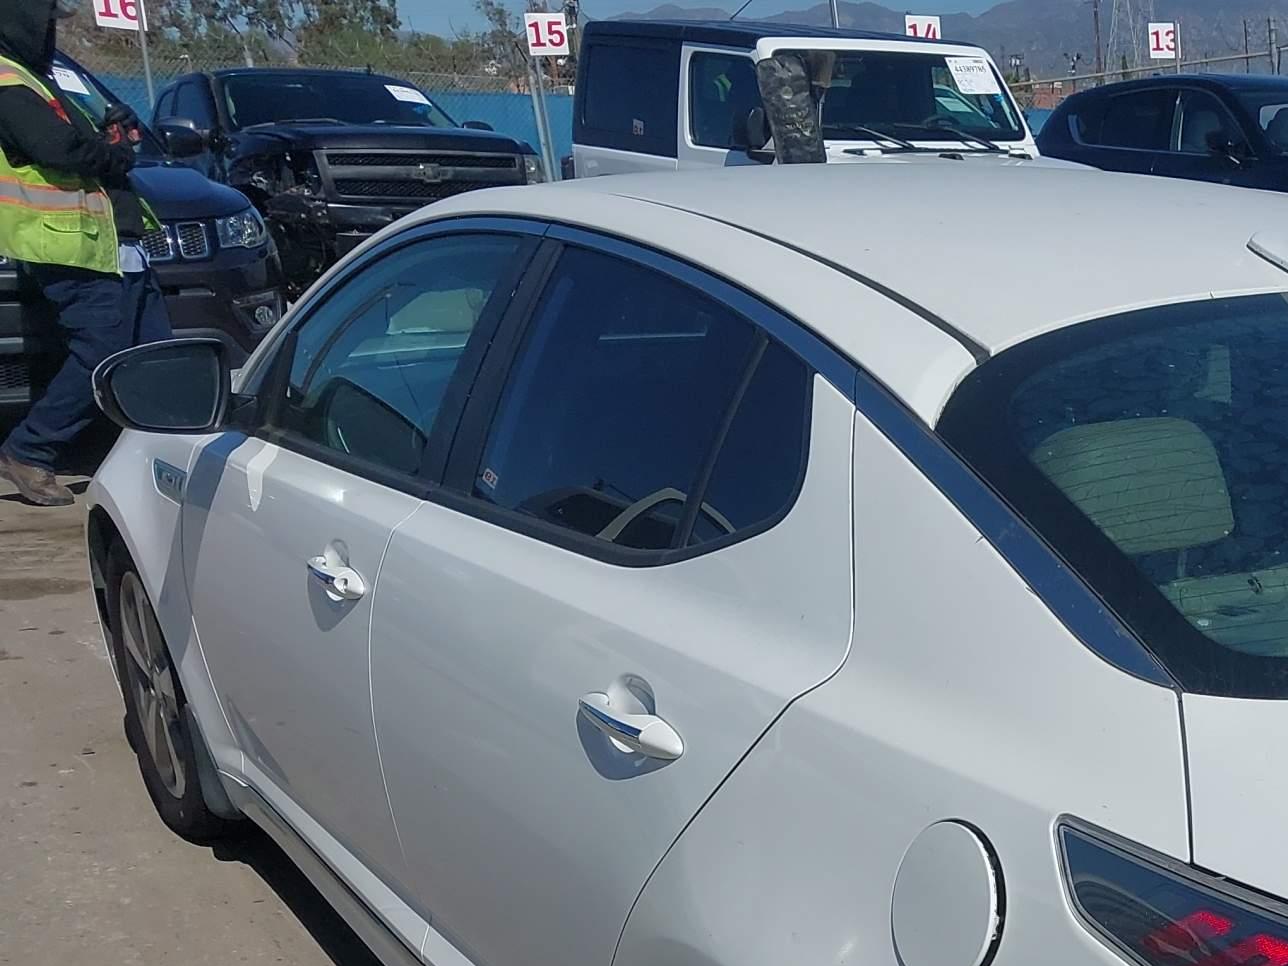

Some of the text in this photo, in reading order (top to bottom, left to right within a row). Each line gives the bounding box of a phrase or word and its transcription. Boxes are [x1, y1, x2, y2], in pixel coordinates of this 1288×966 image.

[98, 0, 139, 20] 16
[528, 21, 565, 47] 15
[1151, 30, 1176, 52] 13
